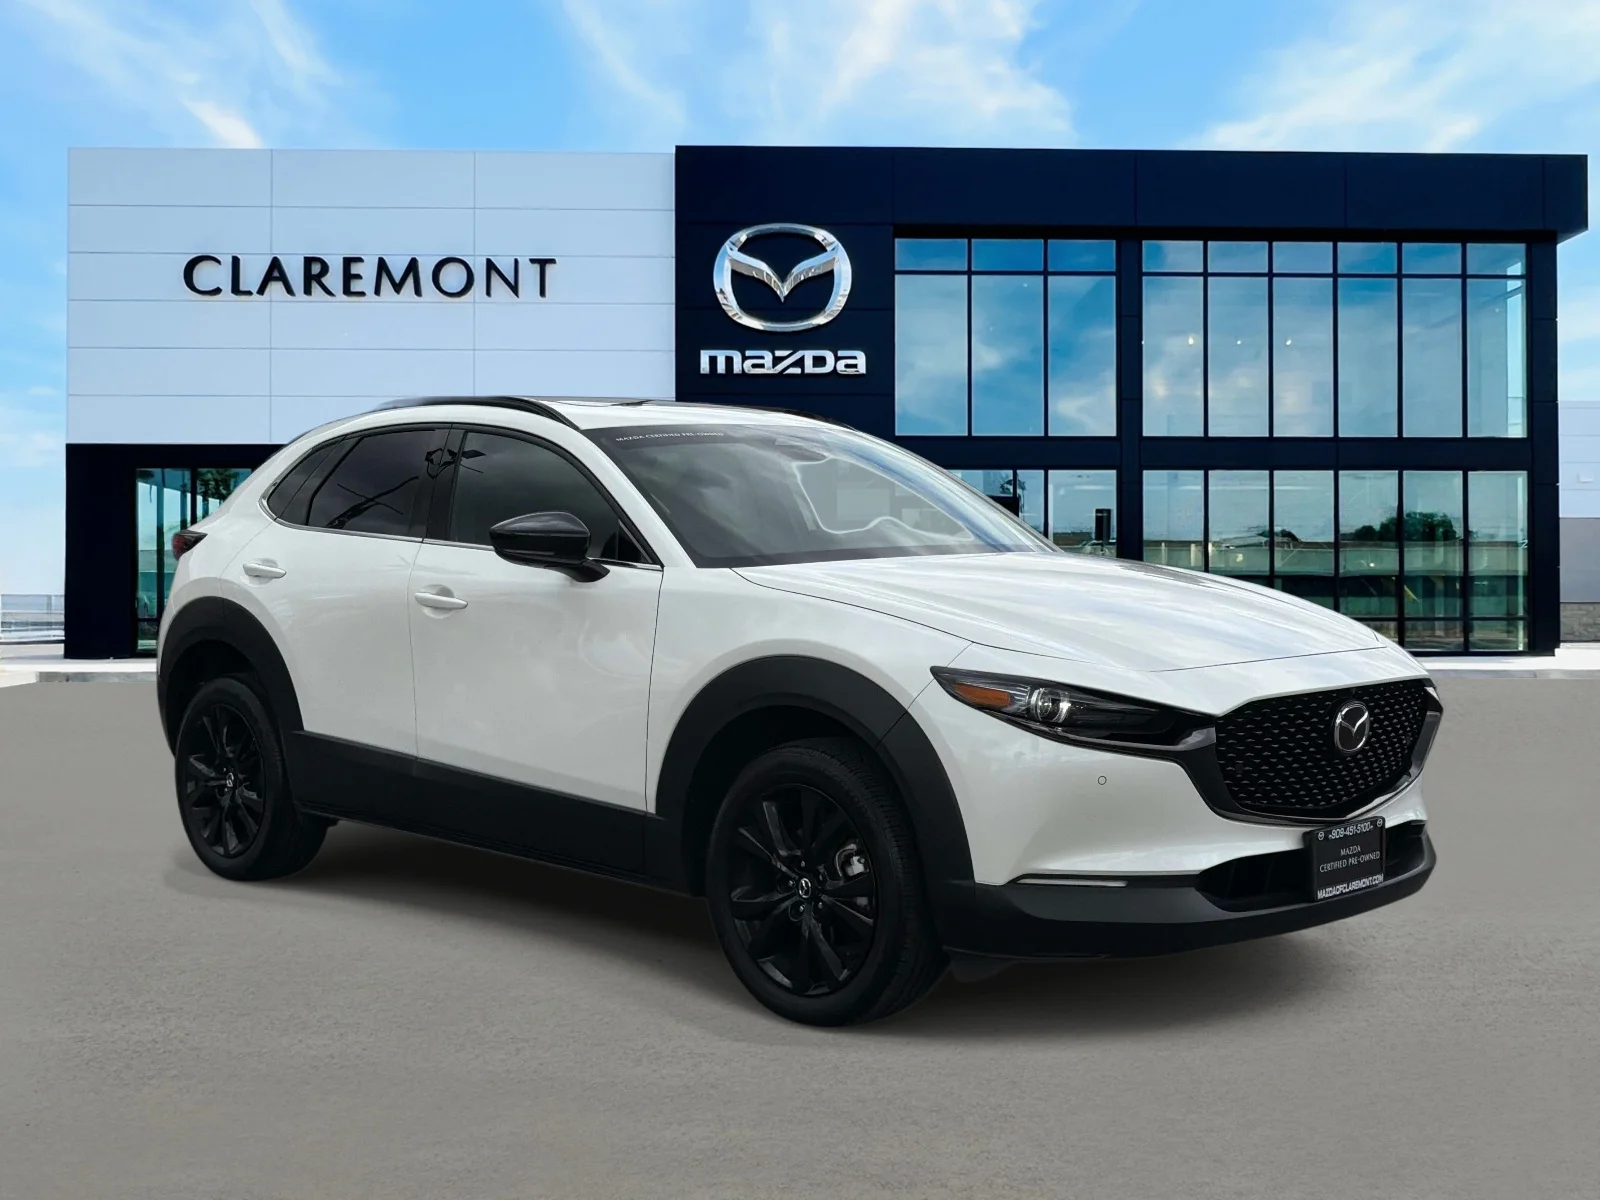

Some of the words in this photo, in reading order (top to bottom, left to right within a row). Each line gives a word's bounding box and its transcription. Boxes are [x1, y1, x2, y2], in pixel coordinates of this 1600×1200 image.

[183, 255, 557, 298] CLAREMONT
[700, 349, 867, 375] mazda
[1319, 860, 1347, 872] CERTIFIED
[1348, 851, 1380, 866] PRE-OWNED
[1340, 845, 1361, 856] MAZDA
[1317, 873, 1384, 900] MAZDAOFCLAREMONT.COM
